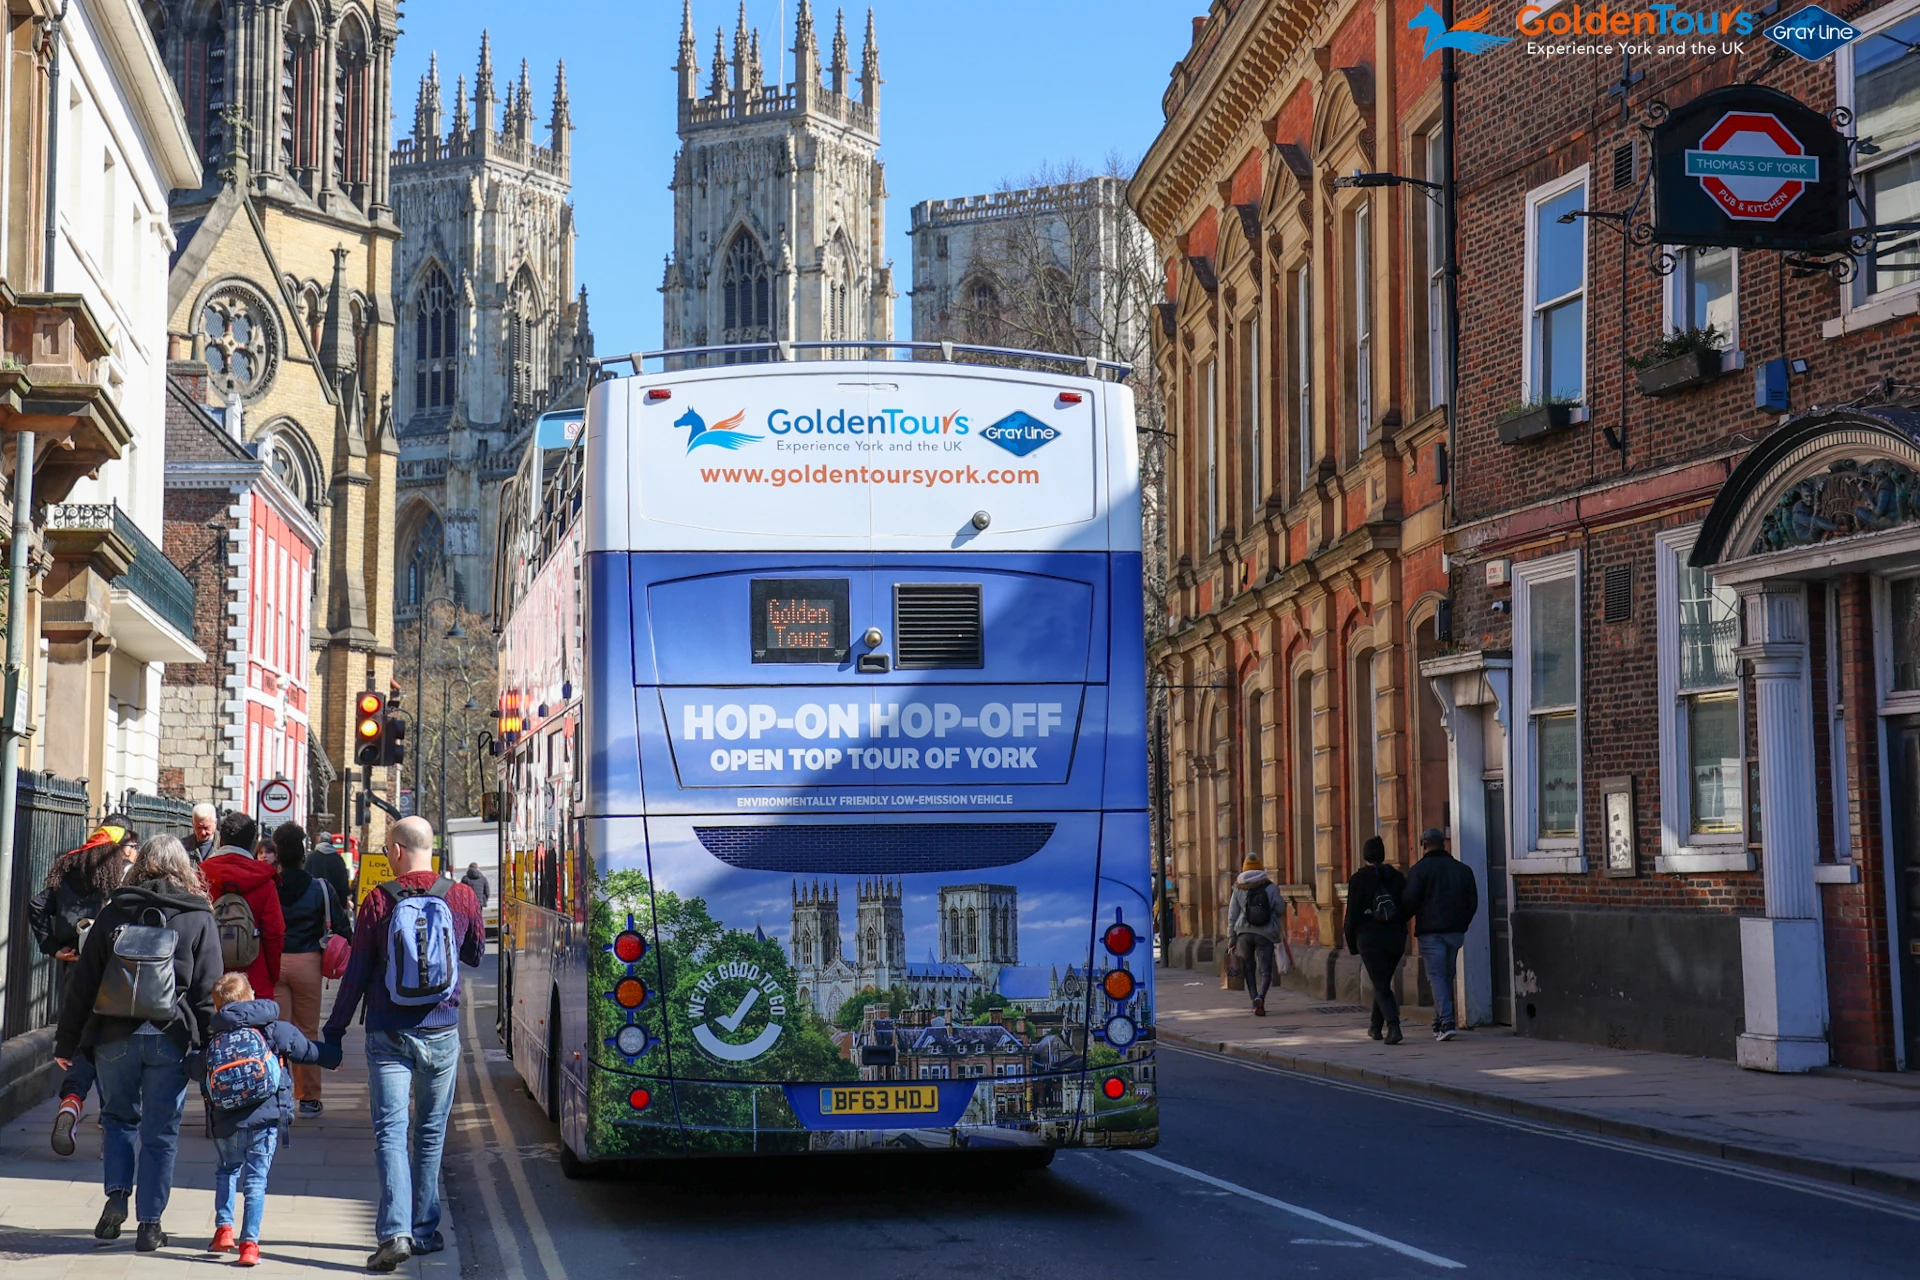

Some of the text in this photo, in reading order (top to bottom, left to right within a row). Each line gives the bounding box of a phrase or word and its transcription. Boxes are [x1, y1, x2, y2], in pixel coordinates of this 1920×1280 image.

[1696, 158, 1807, 174] THOMAS'S OF YORK
[1718, 189, 1788, 213] PUB & KITCHEN
[767, 408, 970, 436] GoldenTours
[985, 427, 1056, 441] Gray Line
[776, 440, 962, 455] Experience York and the UK
[700, 465, 1040, 487] www.goldentoursyork.com
[768, 599, 830, 625] Golden
[774, 626, 829, 647] Tours
[683, 702, 1062, 740] HOP-ON HOP-OFF
[710, 746, 1038, 771] OPEN TOP TOUR OF YORK
[736, 794, 1013, 808] ENVIRONMENTALLY FRIENDLY LOW-EMISSION VEHICLE
[688, 961, 786, 1018] WE'RE GOOD TO GO
[834, 1089, 936, 1110] BF63 HDJ
